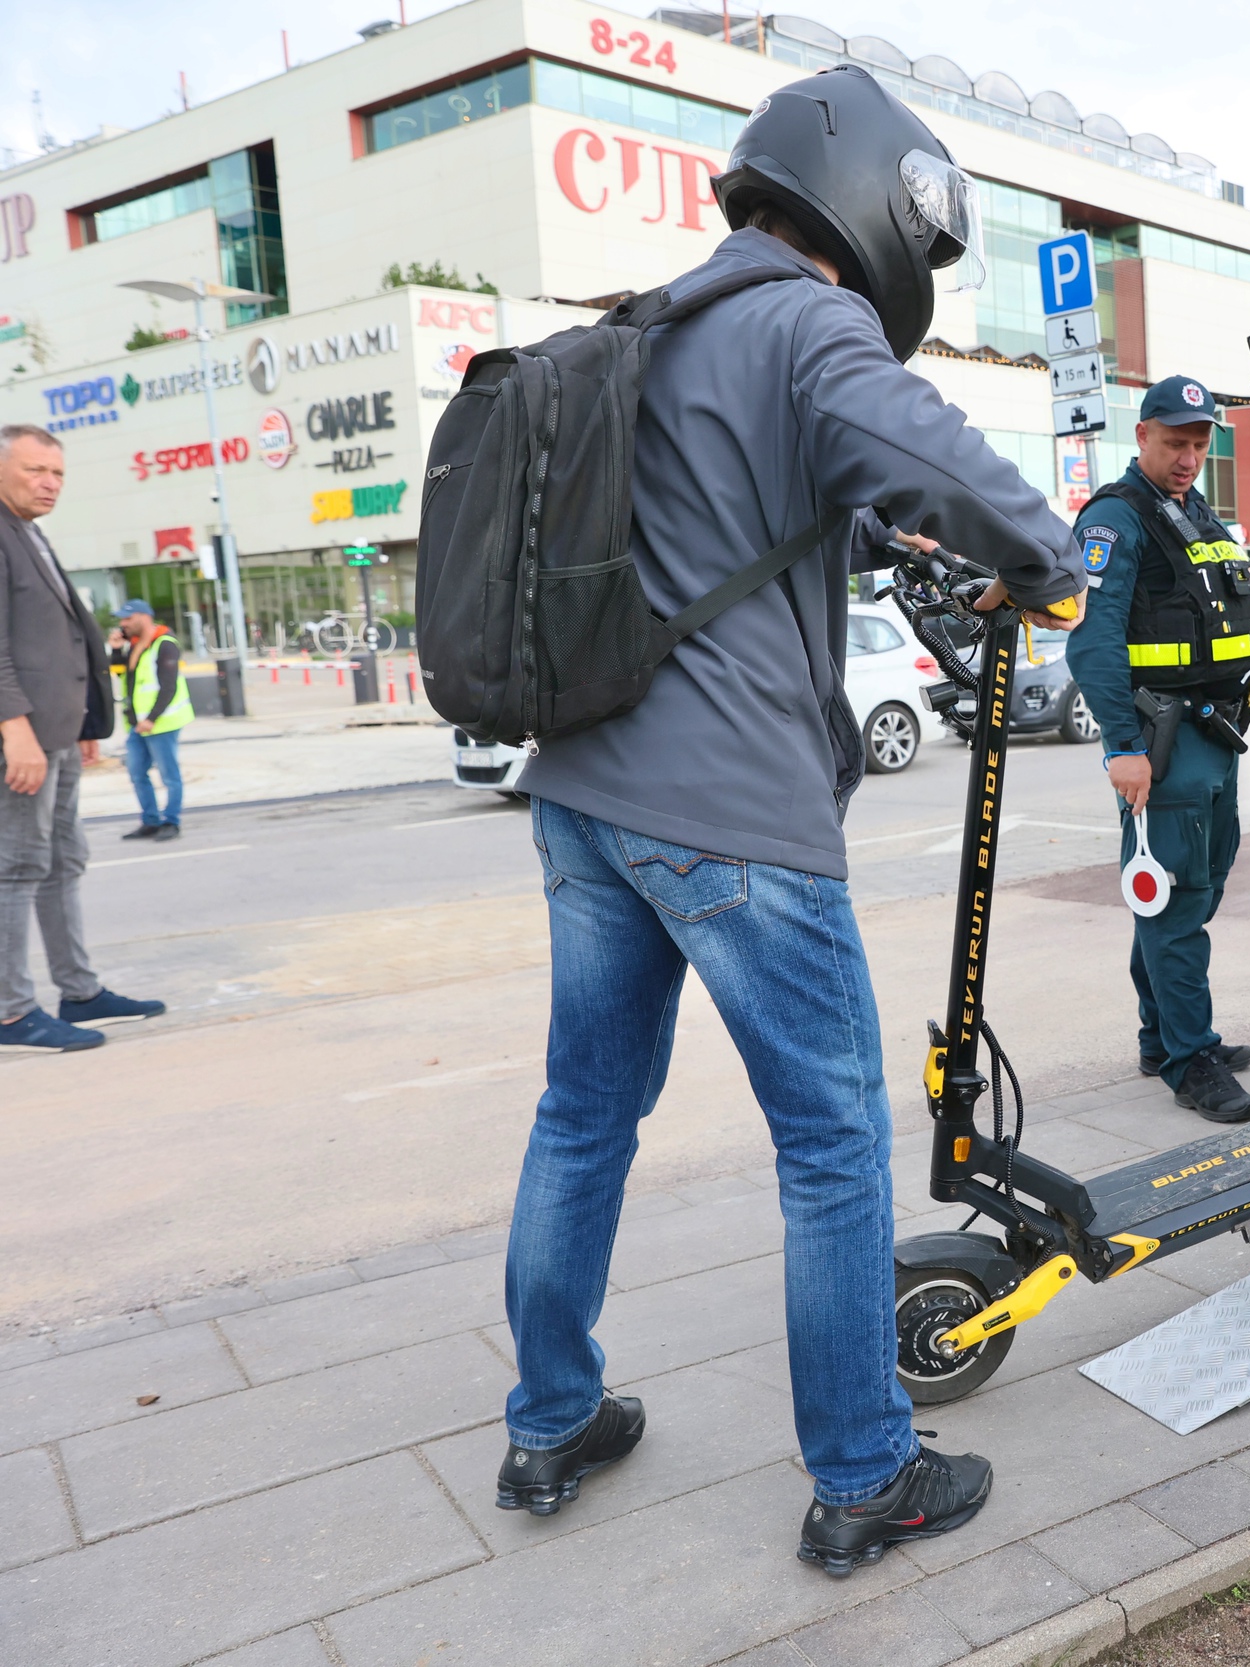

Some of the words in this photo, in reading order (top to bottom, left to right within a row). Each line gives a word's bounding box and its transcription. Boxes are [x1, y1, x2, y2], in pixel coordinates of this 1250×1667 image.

[590, 18, 677, 75] 8-24
[1051, 244, 1081, 307] P
[417, 298, 496, 335] KFC
[43, 376, 116, 416] TOPO
[1065, 368, 1075, 381] 15
[1077, 369, 1086, 380] m
[307, 391, 396, 441] CHARLIE
[333, 445, 376, 474] PIZZA
[310, 479, 407, 525] SUBWAY
[1086, 528, 1115, 540] LIETUVA
[991, 648, 1010, 728] MINI
[977, 748, 1000, 870] BLADE
[961, 890, 986, 1045] TEVERUN
[1151, 1156, 1227, 1189] BLADE
[1169, 1208, 1240, 1238] TEVERUN
